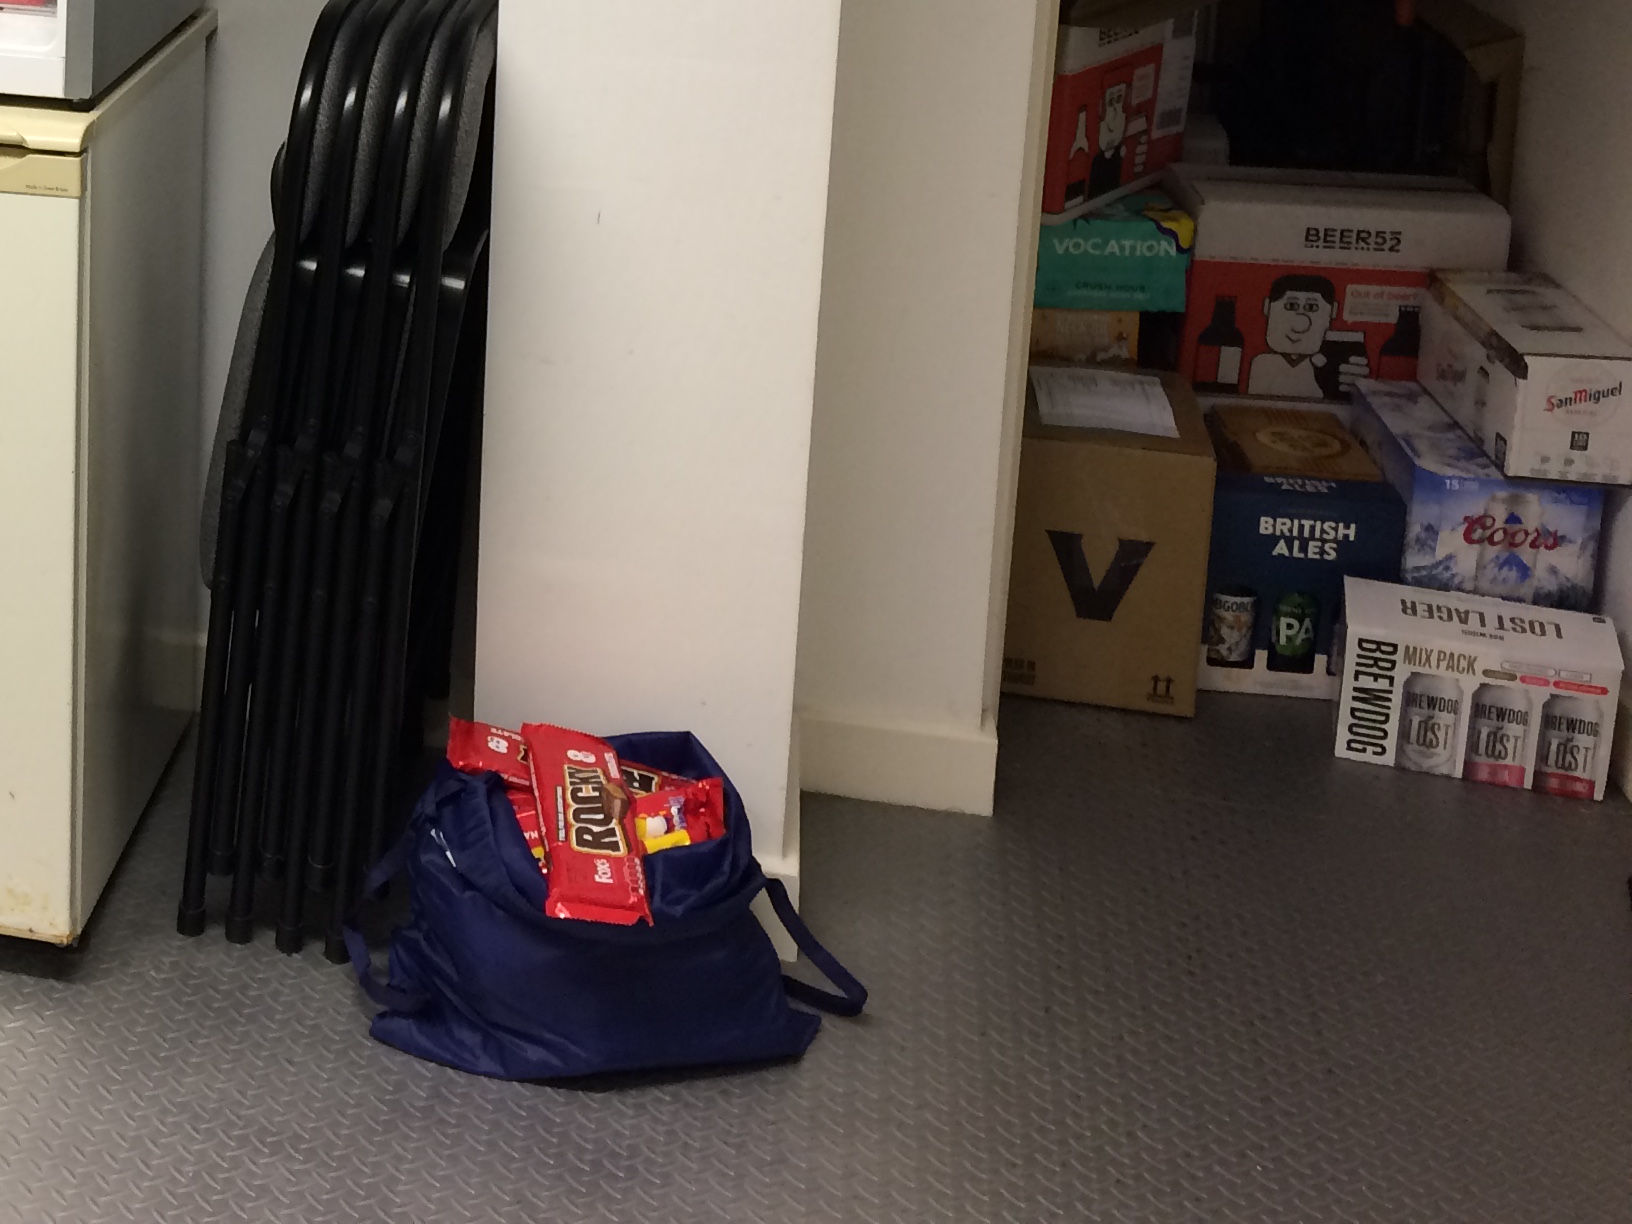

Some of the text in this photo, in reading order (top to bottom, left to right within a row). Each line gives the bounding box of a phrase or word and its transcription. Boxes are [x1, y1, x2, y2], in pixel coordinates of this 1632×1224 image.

[1052, 237, 1178, 258] VOCATION
[1304, 227, 1403, 253] BEER52
[1445, 478, 1460, 490] 15
[1258, 516, 1357, 542] BRITISH
[1462, 514, 1560, 551] Coors
[1271, 539, 1338, 561] ALES
[1044, 529, 1157, 623] V
[1401, 598, 1489, 629] LAGER
[1494, 613, 1564, 640] LOST
[1403, 644, 1434, 669] MIX
[1436, 649, 1478, 677] PACK
[1345, 637, 1399, 758] BREWDOG
[1473, 702, 1530, 727] BREWDOG
[1408, 719, 1453, 752] LOST
[1476, 729, 1522, 762] LOST
[566, 750, 596, 764] 8
[1546, 742, 1592, 774] LOST
[567, 765, 623, 853] ROCKY
